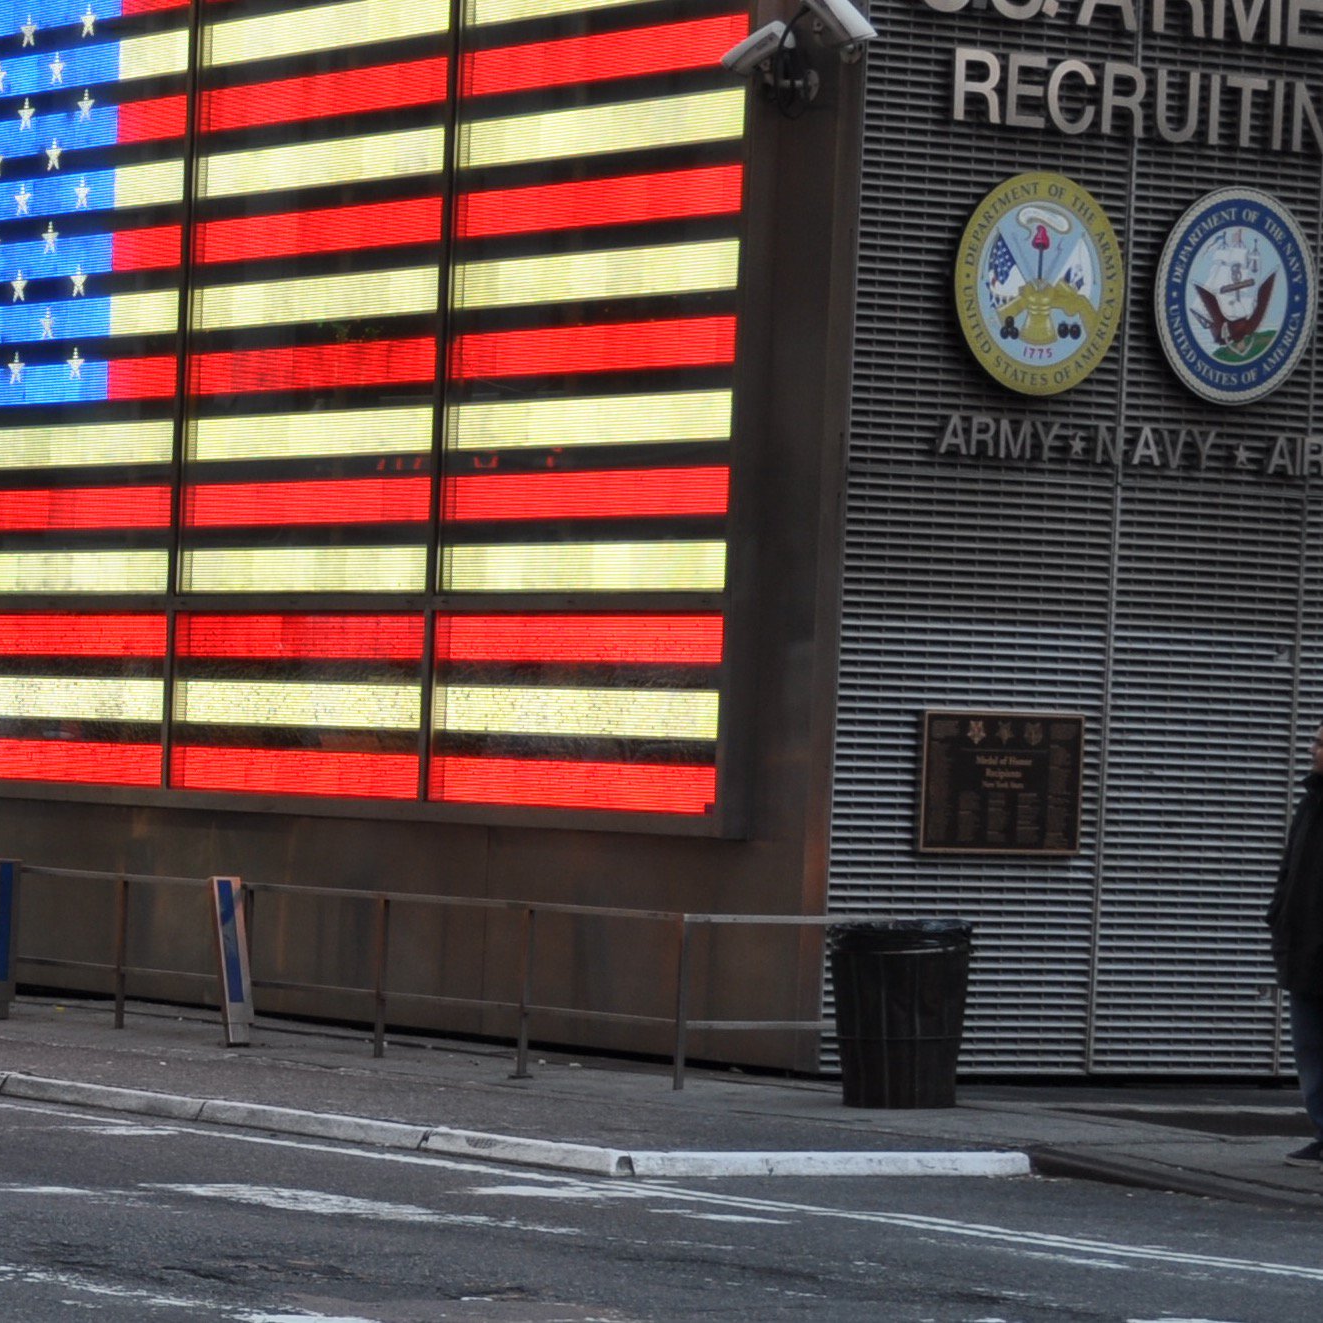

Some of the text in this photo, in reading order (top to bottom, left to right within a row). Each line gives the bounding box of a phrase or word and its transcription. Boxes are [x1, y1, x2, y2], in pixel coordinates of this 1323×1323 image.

[954, 47, 1323, 152] RECRUITIN
[965, 182, 1119, 280] DEPARTMENT OF THE ARMY
[1172, 207, 1303, 285] DEPARTMENT OF THE NAVY
[963, 285, 1115, 386] UNITED STATES OF AMERICA
[1023, 347, 1053, 359] 1775
[1169, 305, 1301, 386] UNITED STATES OF AMERICA
[938, 414, 1323, 476] ARMY NAVY AIR
